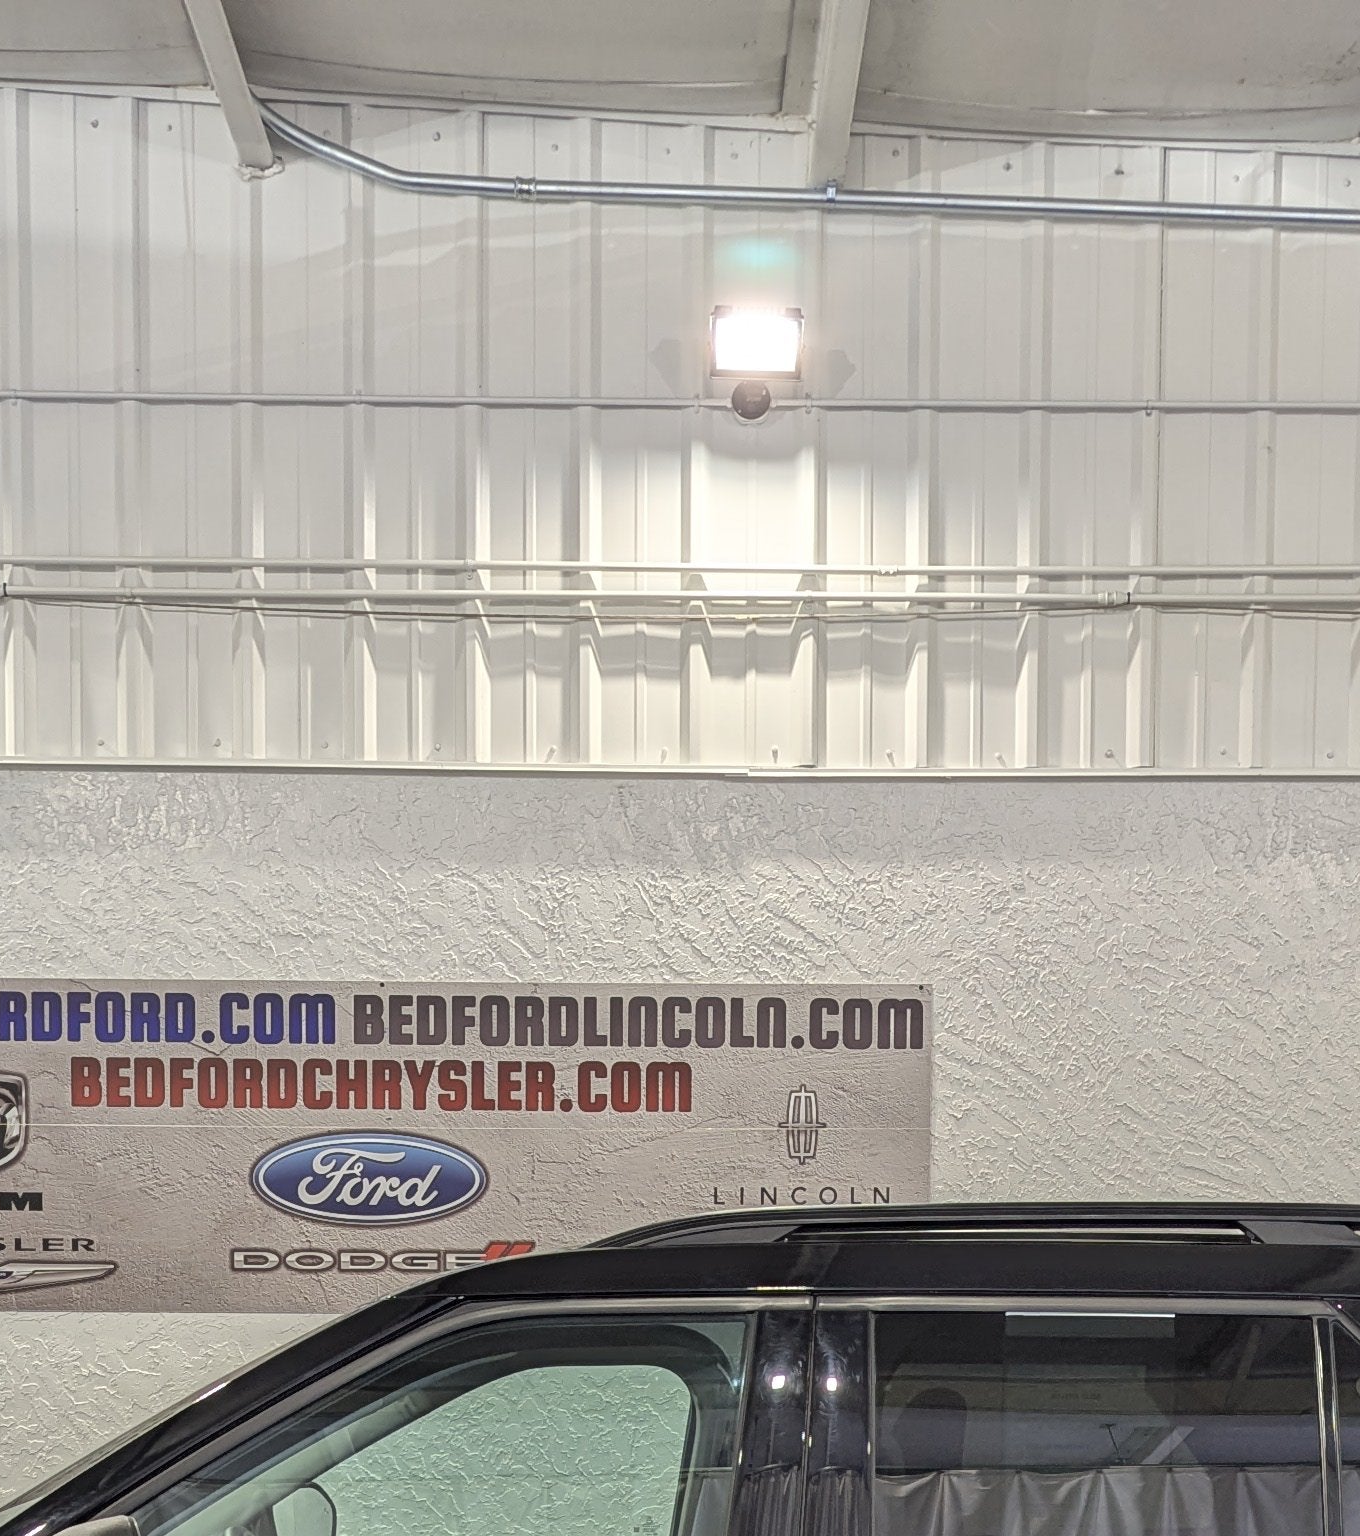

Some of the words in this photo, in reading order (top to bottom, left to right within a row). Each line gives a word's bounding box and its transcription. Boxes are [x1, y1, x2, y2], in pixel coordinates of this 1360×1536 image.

[353, 994, 925, 1049] BEDFORDLINCOLN.COM
[71, 1056, 693, 1112] BEDFORDCHRYSLER.COM
[297, 1148, 442, 1207] Ford
[714, 1187, 890, 1206] LINCOLN
[232, 1250, 490, 1271] DODGE
